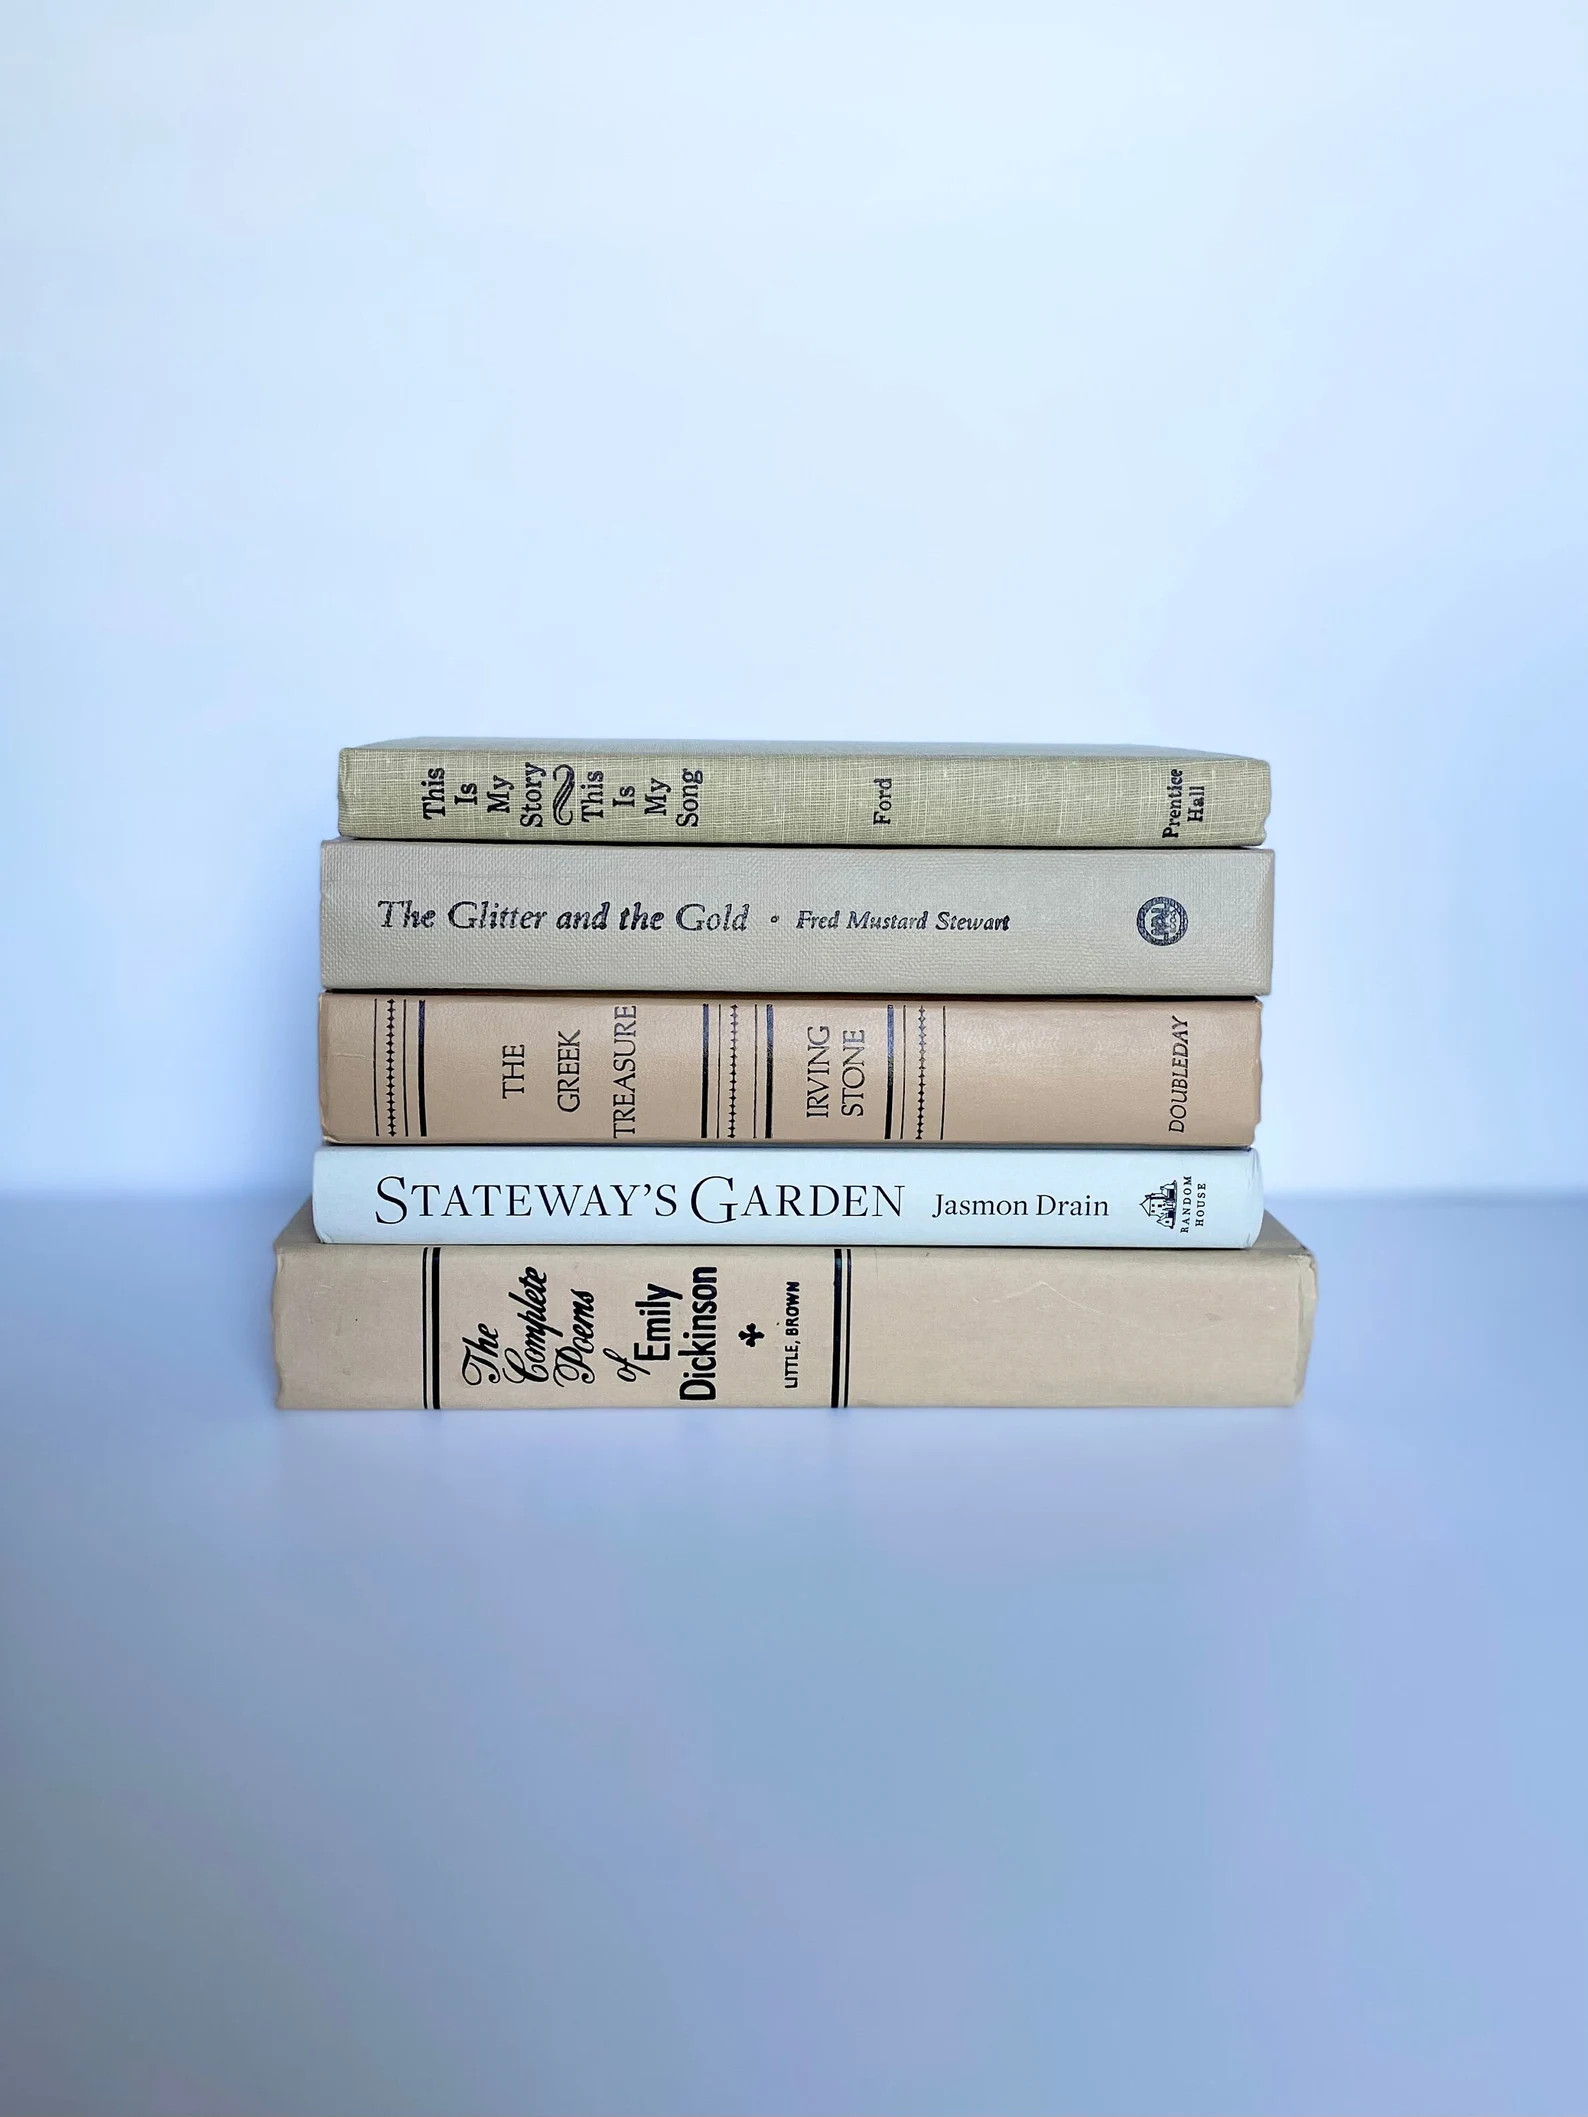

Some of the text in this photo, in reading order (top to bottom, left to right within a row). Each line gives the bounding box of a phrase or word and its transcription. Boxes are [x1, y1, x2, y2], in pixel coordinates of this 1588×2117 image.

[420, 767, 446, 821] This
[453, 782, 478, 806] Is
[486, 774, 515, 814] My
[519, 761, 547, 828] Story
[579, 770, 604, 823] This
[612, 785, 636, 808] Is
[643, 777, 672, 817] My
[675, 767, 704, 828] Song
[872, 778, 893, 826] Ford
[1161, 768, 1183, 839] Prentice
[1186, 785, 1205, 823] Hall
[377, 899, 1011, 932] The Glitter and the Gold Fred Mustard Stewart
[501, 1044, 525, 1100] THE
[557, 1029, 581, 1113] GREEK
[612, 1005, 637, 1140] TREASURE
[806, 1025, 830, 1119] IRVING
[840, 1029, 866, 1117] STONE
[1168, 1015, 1189, 1133] DOUBLEDAY
[375, 1175, 906, 1225] STATEWAY'S GARDEN
[931, 1194, 1108, 1218] Jasmon Drain
[1180, 1175, 1192, 1234] RANDOM
[1194, 1183, 1206, 1227] HOUSE
[502, 1266, 564, 1385] Complete
[552, 1288, 596, 1388] Poems
[633, 1283, 683, 1361] Emily
[677, 1266, 718, 1401] Dickinson
[784, 1281, 801, 1389] LITTLE, BROWN
[461, 1322, 501, 1386] The
[602, 1345, 653, 1383] of
